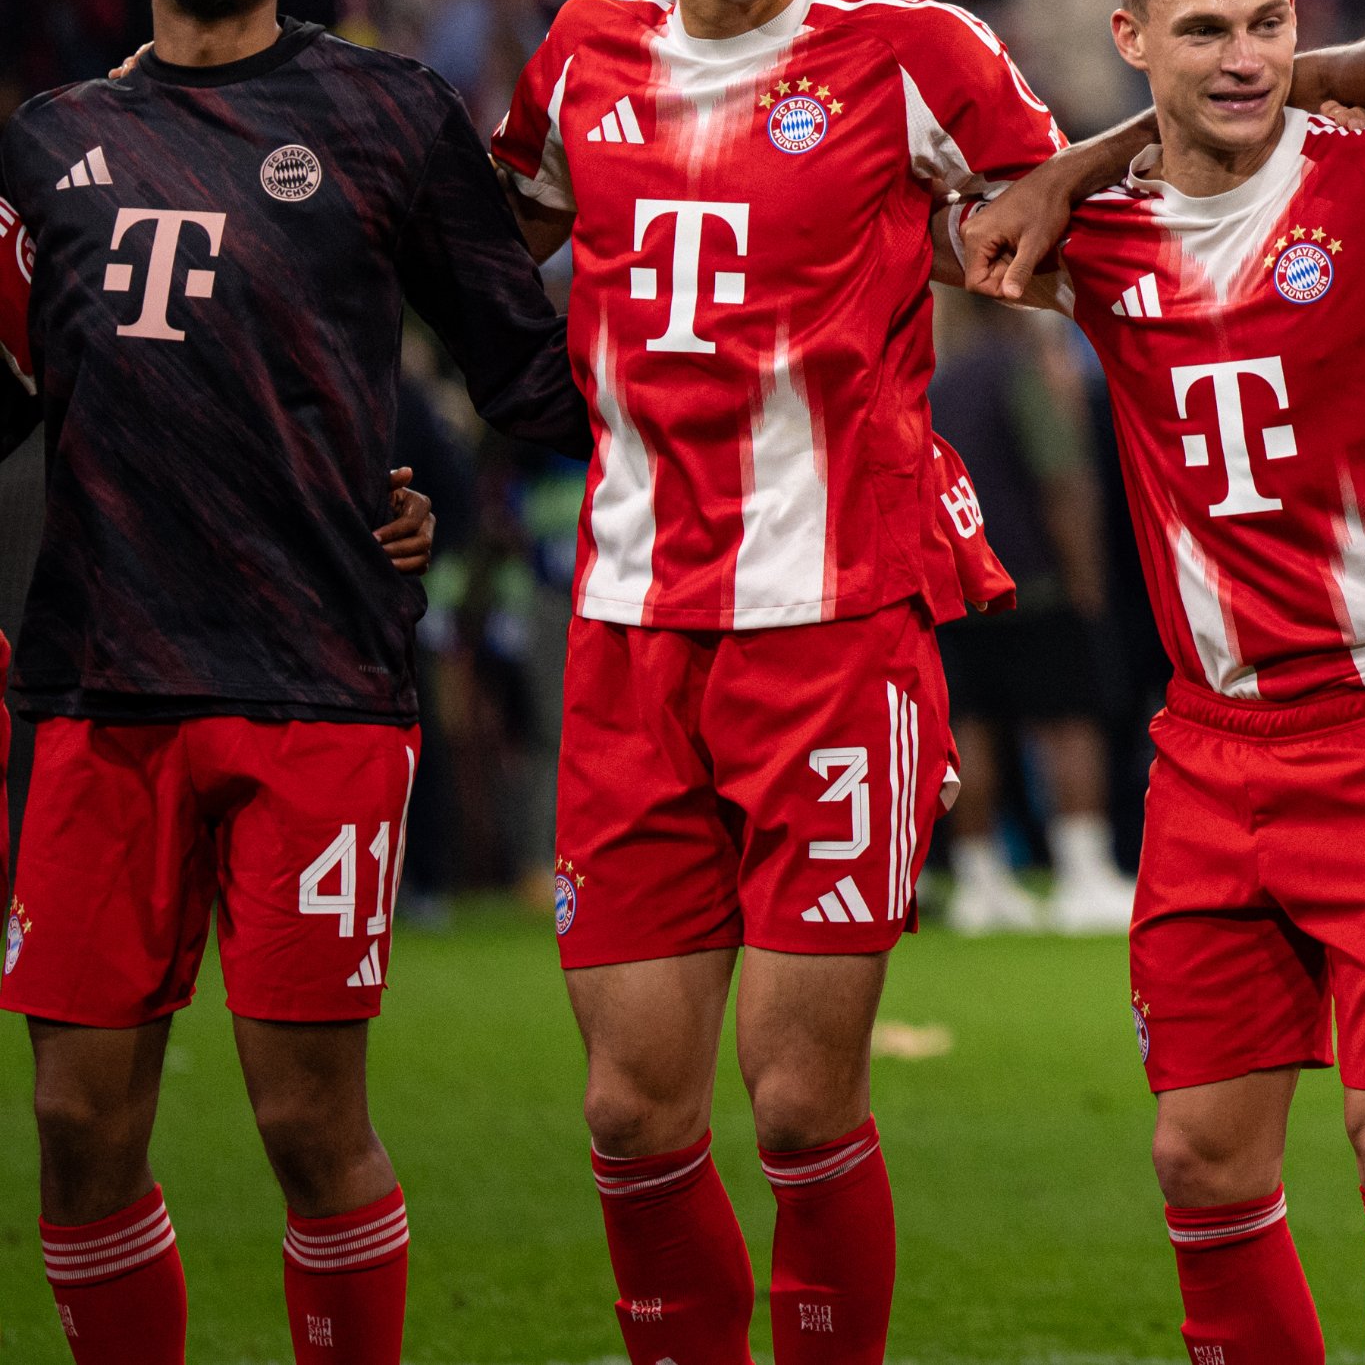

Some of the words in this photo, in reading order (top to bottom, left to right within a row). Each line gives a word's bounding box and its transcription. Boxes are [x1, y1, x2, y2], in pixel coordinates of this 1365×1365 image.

[775, 106, 787, 120] FC
[788, 100, 823, 123] BAYERN
[268, 155, 280, 168] FC
[281, 150, 316, 173] BAYERN
[1279, 259, 1289, 273] FC
[1288, 248, 1327, 267] BAYERN
[103, 207, 226, 341] T
[630, 199, 750, 354] T
[1171, 355, 1297, 517] T
[808, 747, 871, 860] 3
[299, 821, 390, 937] 41
[799, 1302, 831, 1313] MIA
[307, 1314, 331, 1326] MIA
[801, 1322, 834, 1332] MIA
[309, 1335, 334, 1347] MIA
[1194, 1345, 1223, 1356] MIA
